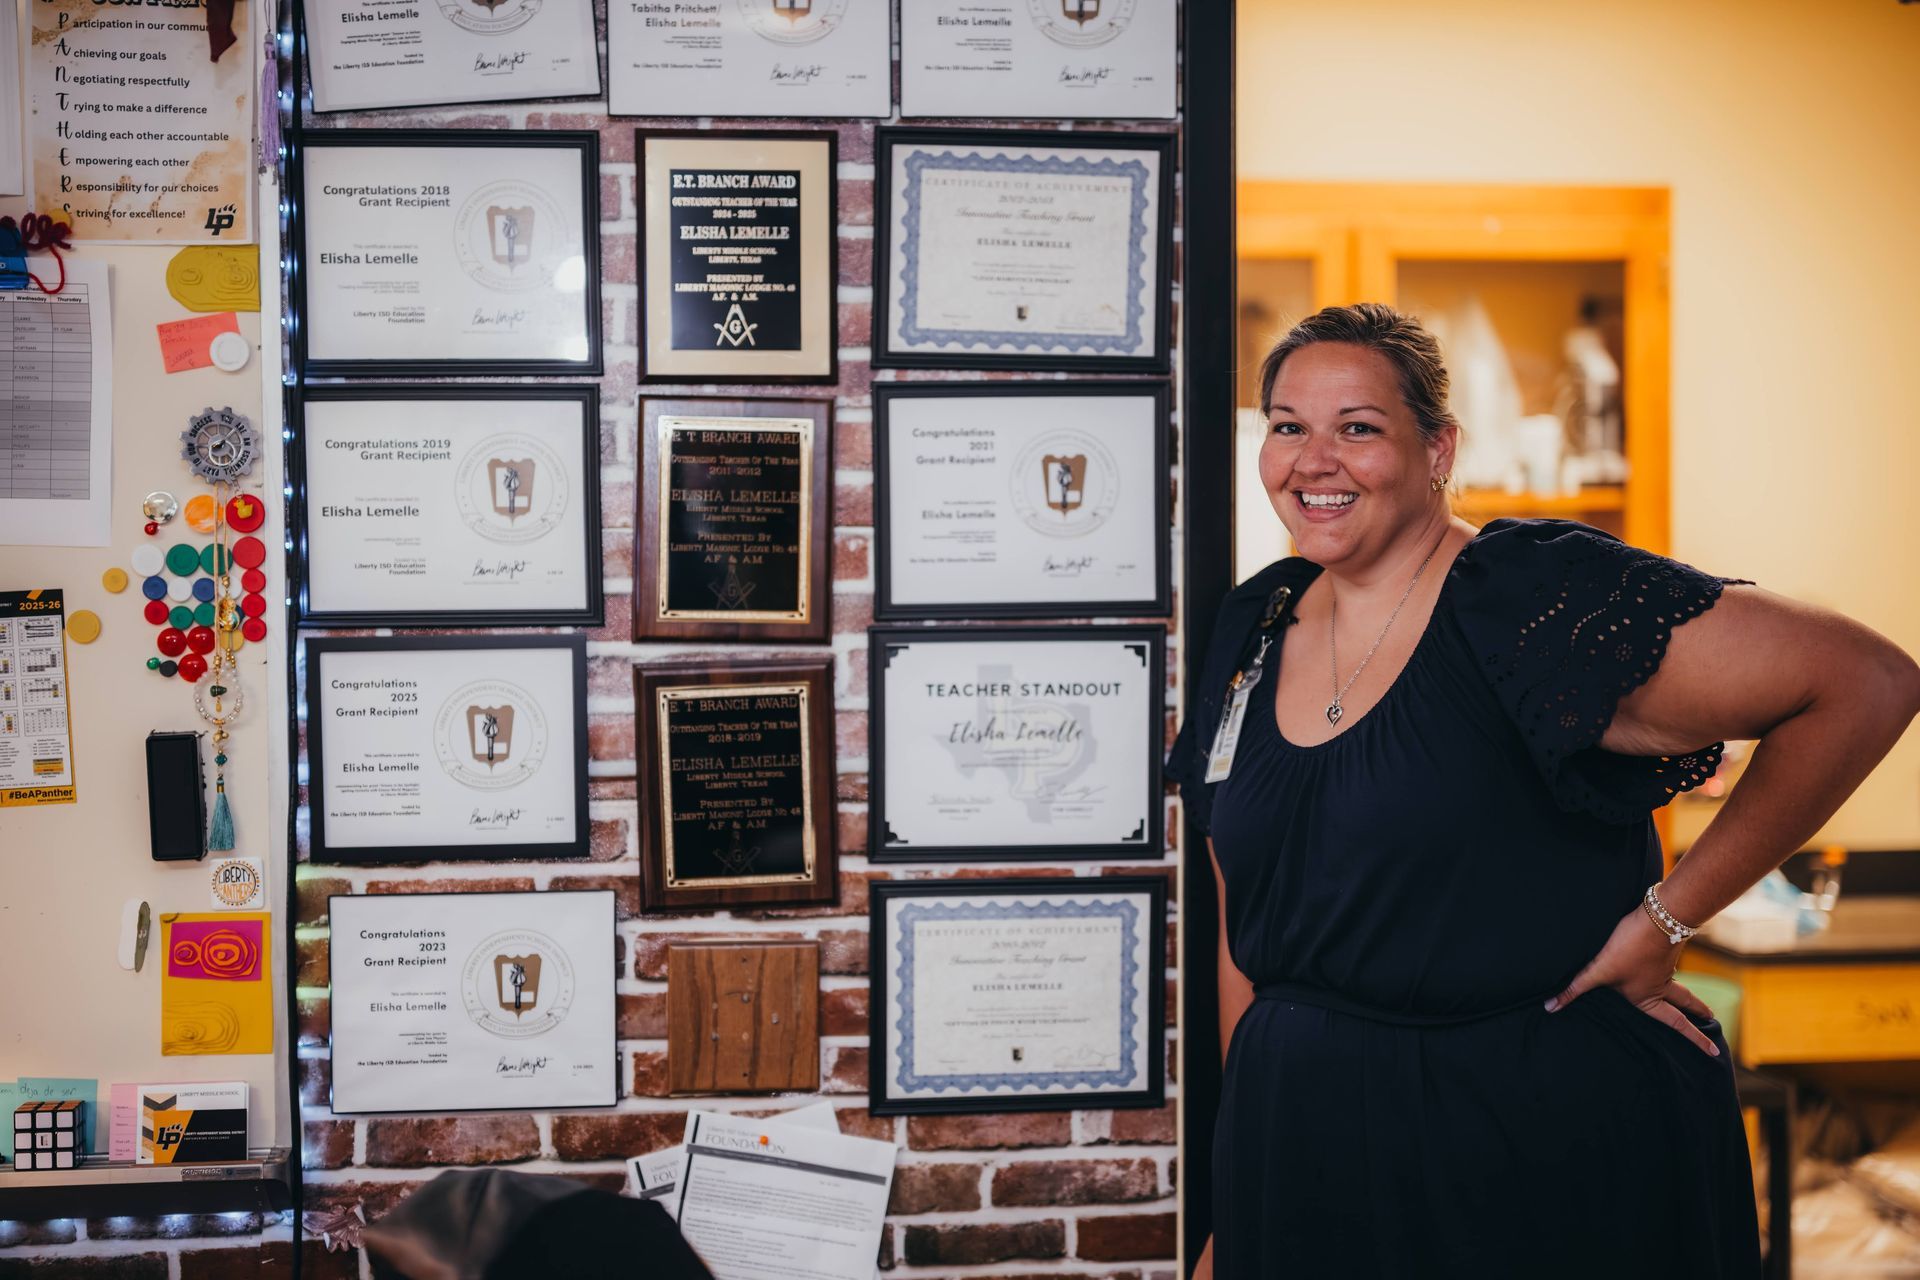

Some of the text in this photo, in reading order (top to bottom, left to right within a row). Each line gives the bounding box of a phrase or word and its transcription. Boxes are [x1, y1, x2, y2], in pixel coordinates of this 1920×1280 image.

[631, 3, 670, 13] Tabitha
[342, 9, 419, 23] Elisha Lemelle
[938, 16, 1011, 26] Elisha Lemelle
[136, 20, 144, 29] in
[646, 18, 720, 27] Elisha Lemelle
[140, 52, 166, 62] goals
[128, 77, 190, 88] respectfully
[116, 104, 143, 112] make
[155, 104, 207, 114] difference
[110, 131, 134, 139] each
[136, 132, 164, 140] other
[167, 133, 228, 141] accountable
[136, 158, 159, 166] each
[673, 174, 796, 188] E.T. BRANCH AWARD
[144, 183, 158, 192] for
[162, 186, 178, 194] our
[181, 184, 218, 192] choices
[323, 185, 450, 196] Congratulations 2018
[359, 197, 450, 208] Grant Recipient
[112, 209, 127, 218] for
[130, 208, 185, 218] excellence!
[680, 226, 789, 239] ELISHA LEMELLE
[320, 253, 418, 264] Elisha Lemelle
[702, 432, 799, 444] BRANCH AWARD
[912, 428, 995, 439] Congratulations
[325, 440, 450, 450] Congratulations 2019
[970, 442, 993, 450] 2021
[360, 451, 450, 462] Grant Recipient
[916, 456, 995, 465] Grant Recipient
[672, 489, 800, 504] ELISHA LEMELLE
[322, 506, 419, 517] Elisha Lemelle
[922, 510, 996, 520] Elisha Lemelle
[20, 601, 60, 610] 2025-26
[332, 680, 417, 690] Congratulations
[926, 683, 1121, 696] TEACHER STANDOUT
[391, 693, 417, 702] 2025
[700, 697, 797, 711] BRANCH AWARD
[336, 707, 418, 718] Grant Recipient
[949, 716, 1084, 744] Elisha Lemelle
[343, 763, 419, 772] Elisha Lemelle
[672, 754, 799, 771] ELISHA LEMELLE
[9, 789, 72, 799] #BeAPanther
[218, 866, 250, 884] LIBERTY
[360, 930, 445, 940] Congratulations
[420, 943, 445, 952] 2023
[364, 957, 446, 967] Grant Recipient
[370, 1002, 446, 1012] Elisha Lemelle
